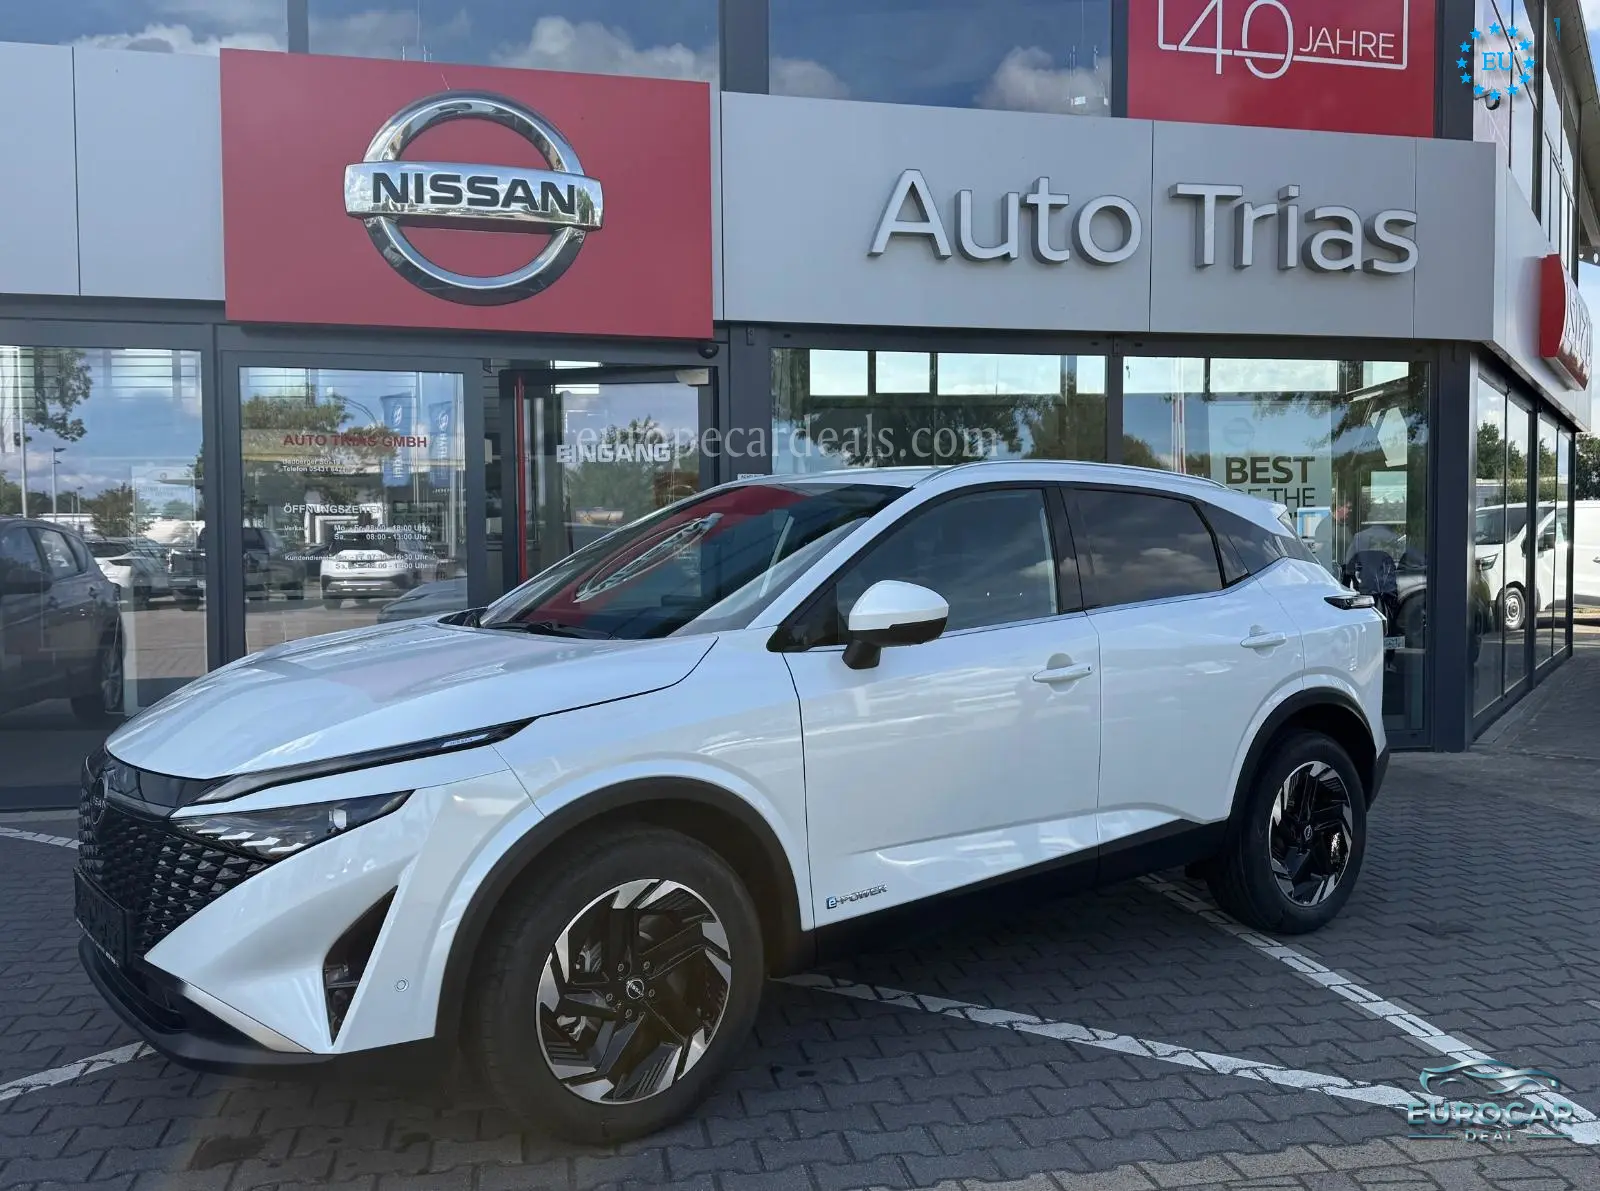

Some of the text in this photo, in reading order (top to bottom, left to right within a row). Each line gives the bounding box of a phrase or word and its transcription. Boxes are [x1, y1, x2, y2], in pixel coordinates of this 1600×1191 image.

[1178, 0, 1395, 79] 40 JAHRE
[372, 172, 575, 215] NISSAN
[867, 168, 1419, 275] Auto Trias
[283, 435, 327, 447] AUTO
[381, 436, 427, 448] GMBH
[556, 443, 671, 463] EINGANG
[1225, 456, 1315, 484] BEST
[1267, 487, 1315, 507] THE
